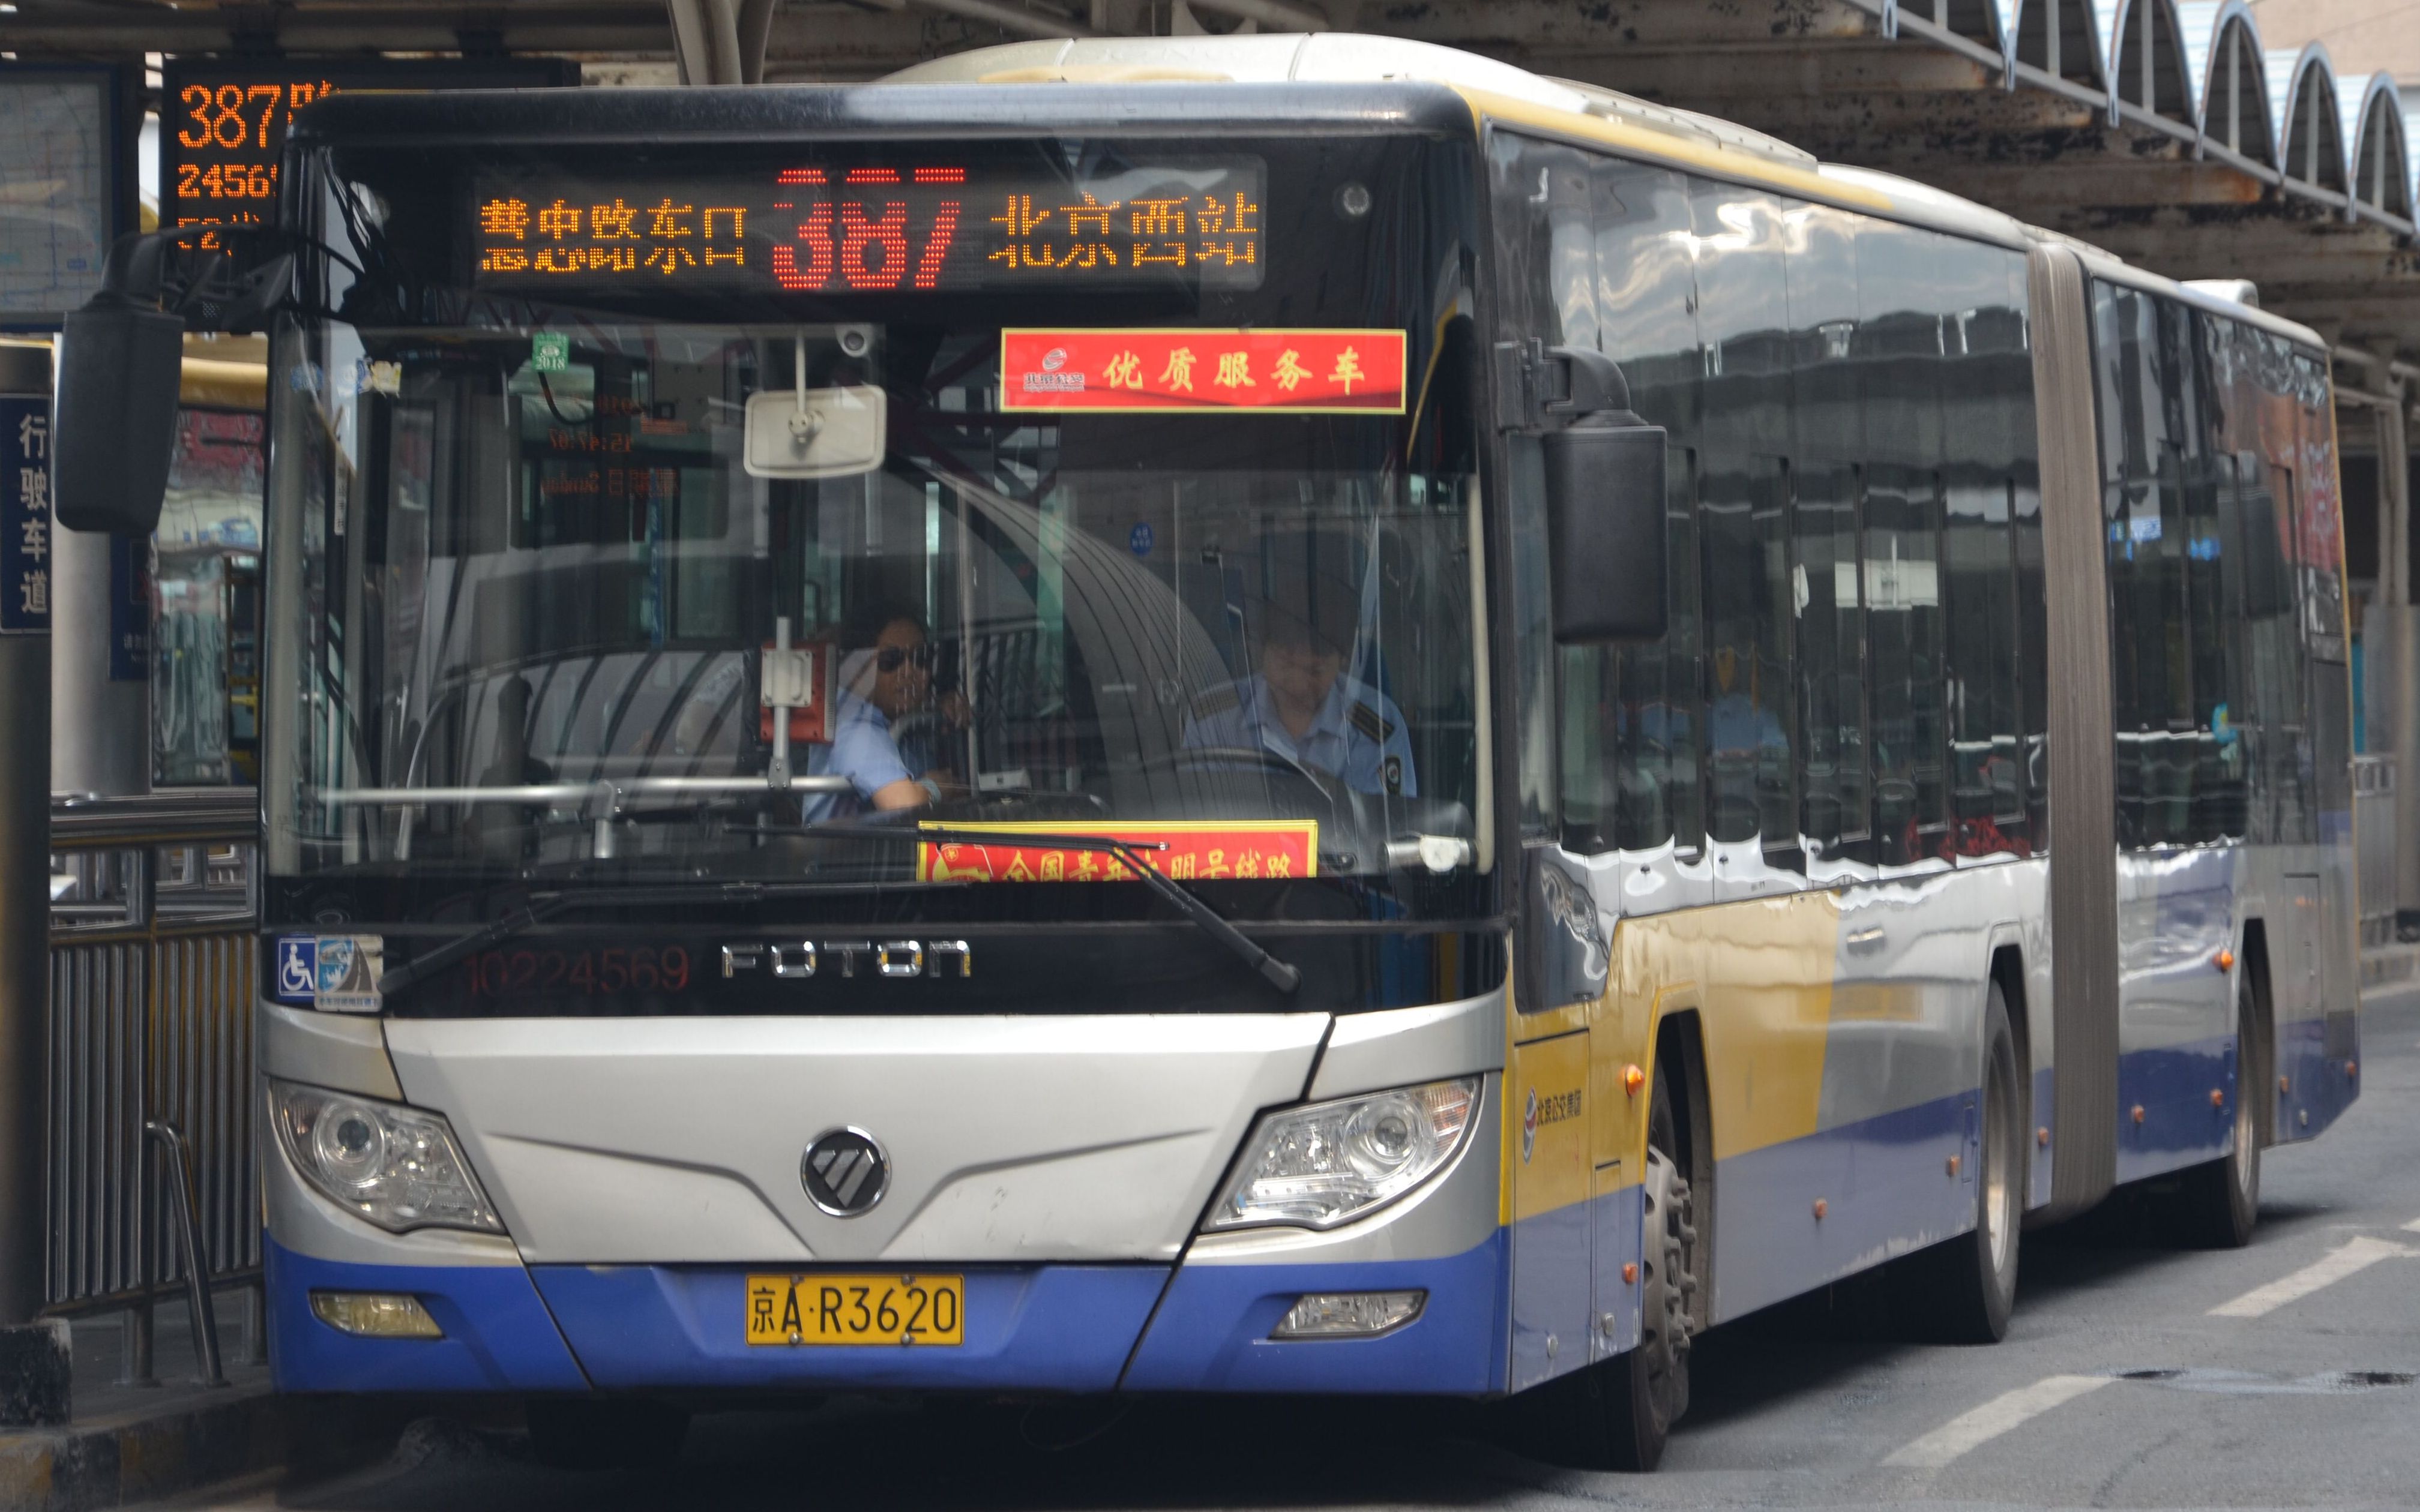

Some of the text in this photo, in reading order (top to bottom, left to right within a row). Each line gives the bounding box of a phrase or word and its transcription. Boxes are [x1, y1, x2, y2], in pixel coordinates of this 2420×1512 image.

[481, 167, 1257, 289] 慧忠路东口 387 北京西站
[1103, 345, 1365, 396] 优质服务车
[19, 413, 47, 614] 行驶车道
[721, 940, 971, 978] FOTON
[1537, 1089, 1582, 1126] 北京公交集团
[752, 1286, 957, 1334] 京A·R3620
